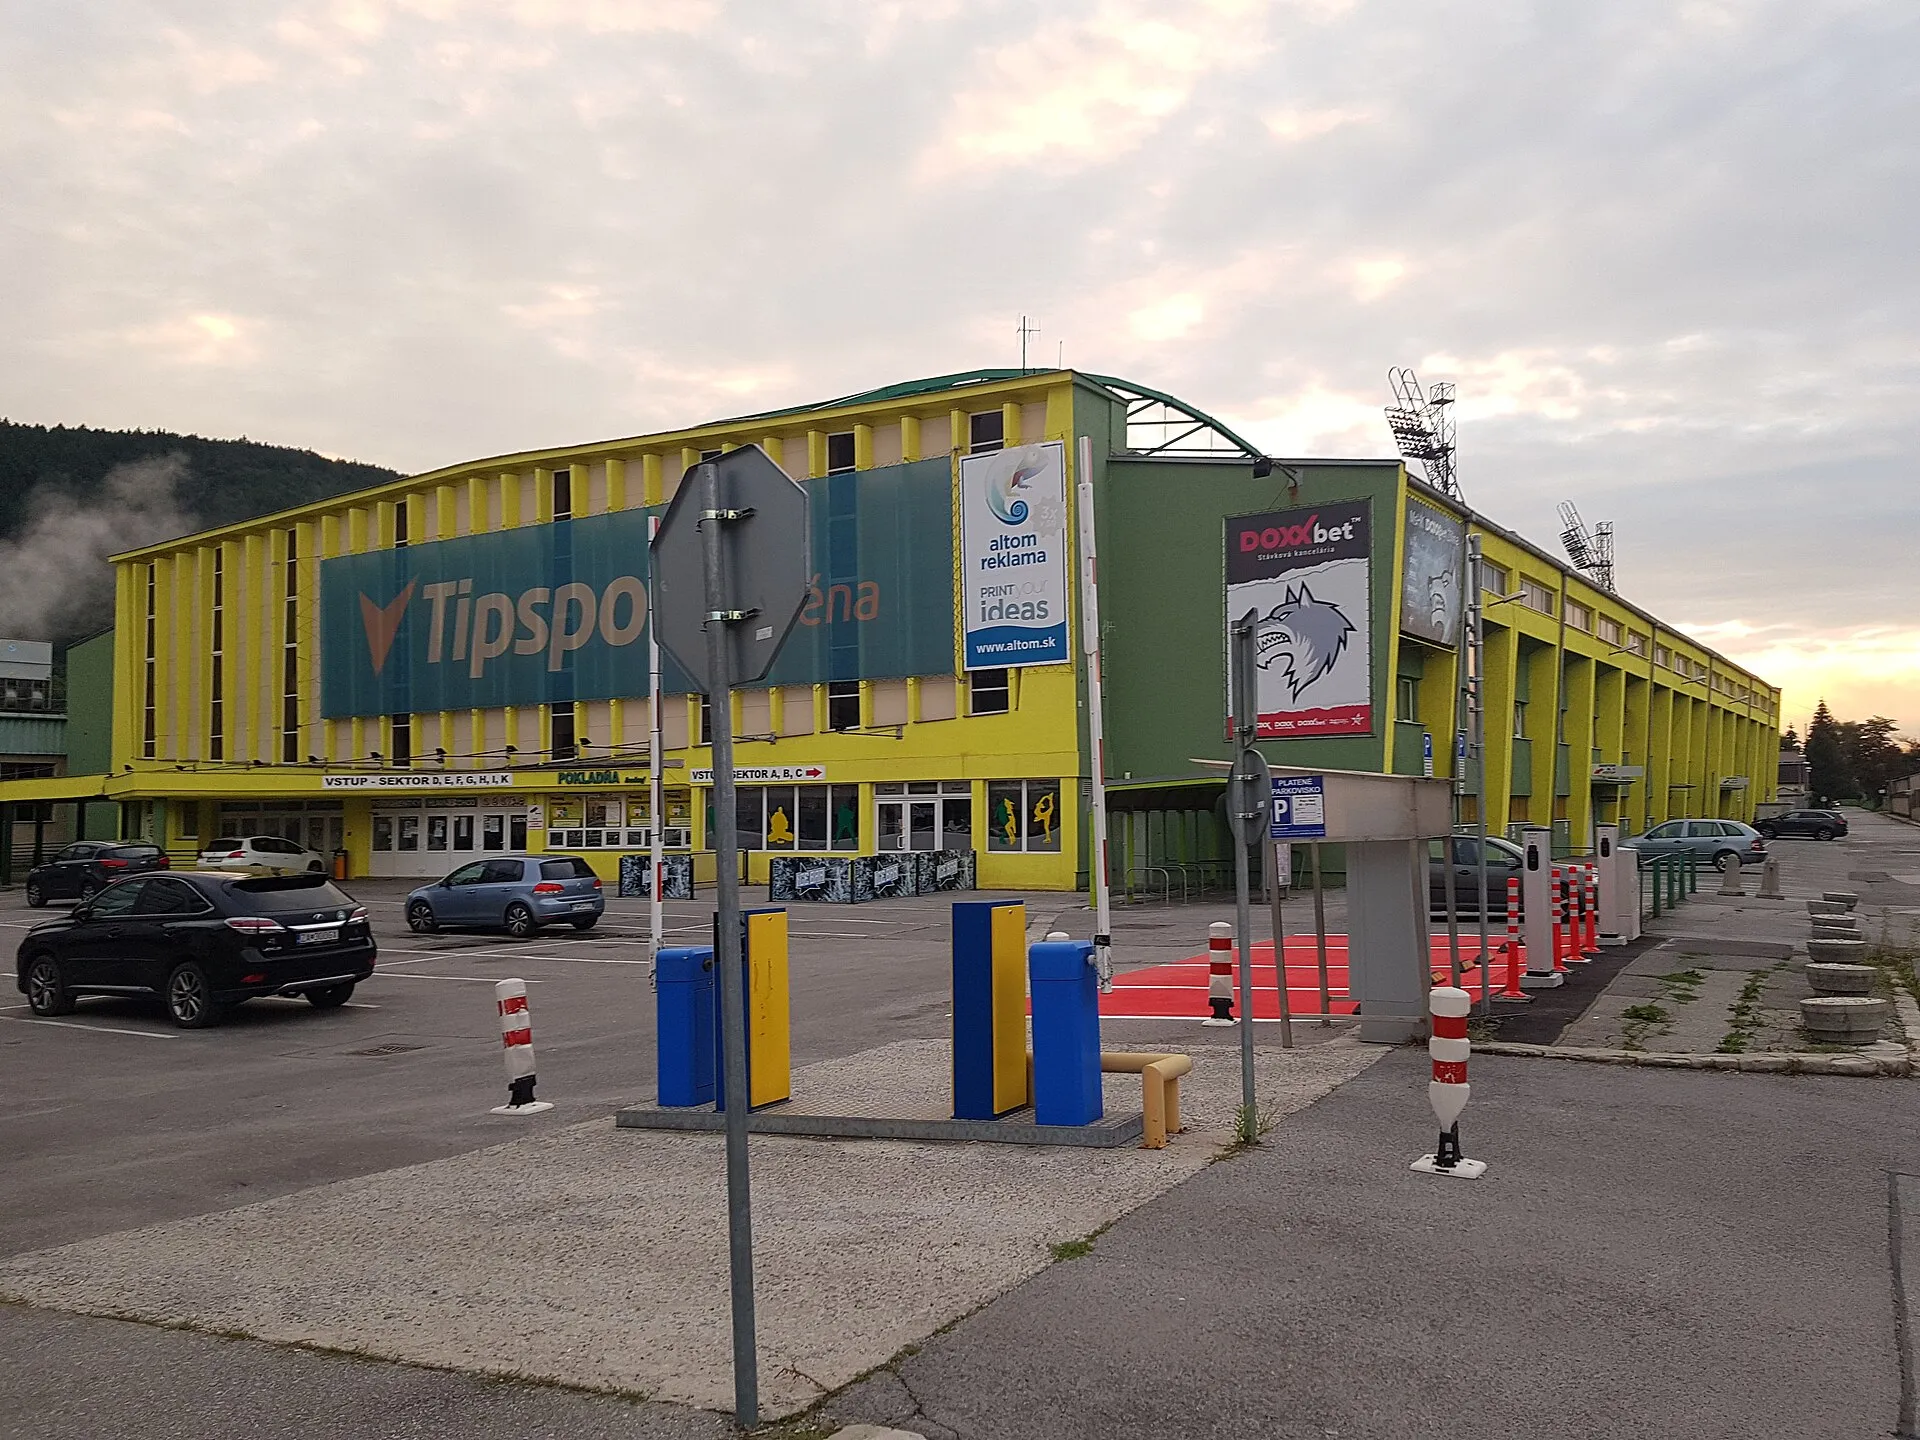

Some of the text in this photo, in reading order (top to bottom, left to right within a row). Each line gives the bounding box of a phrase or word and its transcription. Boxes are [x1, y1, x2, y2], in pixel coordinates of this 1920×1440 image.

[990, 534, 1037, 551] altom
[981, 551, 1046, 570] reklama
[980, 584, 1015, 598] PRINT
[980, 598, 1049, 622] ideas
[422, 573, 880, 679] Tipspo éna
[976, 637, 1056, 653] www.altom.sk
[325, 777, 368, 786] VSTUP
[379, 776, 430, 786] SEKTOR
[432, 776, 442, 785] D,
[444, 776, 454, 785] E,
[456, 776, 464, 785] F,
[466, 775, 477, 785] G,
[479, 775, 490, 784] H,
[500, 774, 509, 784] K
[692, 770, 715, 780] VSTU
[770, 769, 781, 780] A,
[783, 769, 793, 780] B,
[795, 768, 803, 778] C
[1271, 786, 1321, 795] PARKOVISKO
[1273, 799, 1288, 822] P
